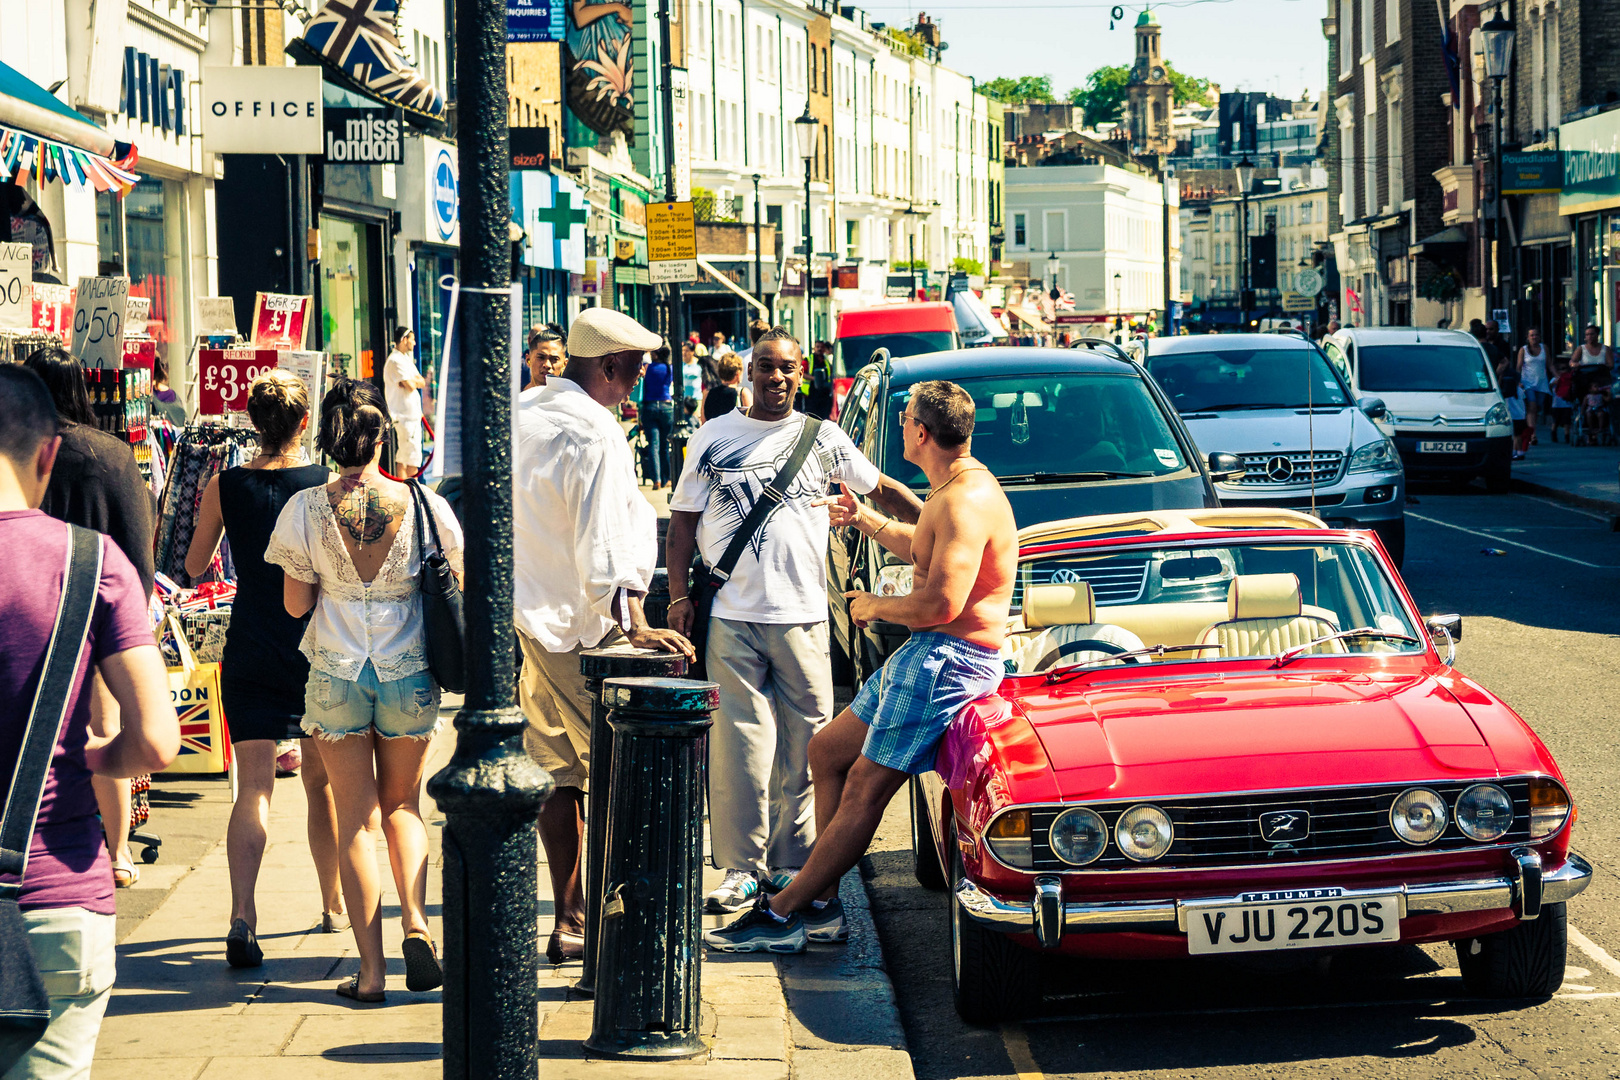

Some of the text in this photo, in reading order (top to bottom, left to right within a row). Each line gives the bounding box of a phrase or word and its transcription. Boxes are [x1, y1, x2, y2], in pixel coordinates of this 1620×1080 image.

[211, 101, 315, 117] OFFICE
[346, 113, 399, 141] miss
[327, 131, 400, 161] london
[513, 153, 545, 166] size?
[1502, 153, 1557, 164] Poundland
[1565, 135, 1617, 186] Poundland
[77, 278, 128, 300] MAGNETS
[38, 301, 62, 335] £1
[75, 307, 120, 344] 0.50
[269, 311, 293, 341] £1
[1424, 442, 1464, 451] LJ12 CXZ
[1247, 889, 1339, 901] TRIUMPH
[1203, 902, 1384, 945] VJU 220S
